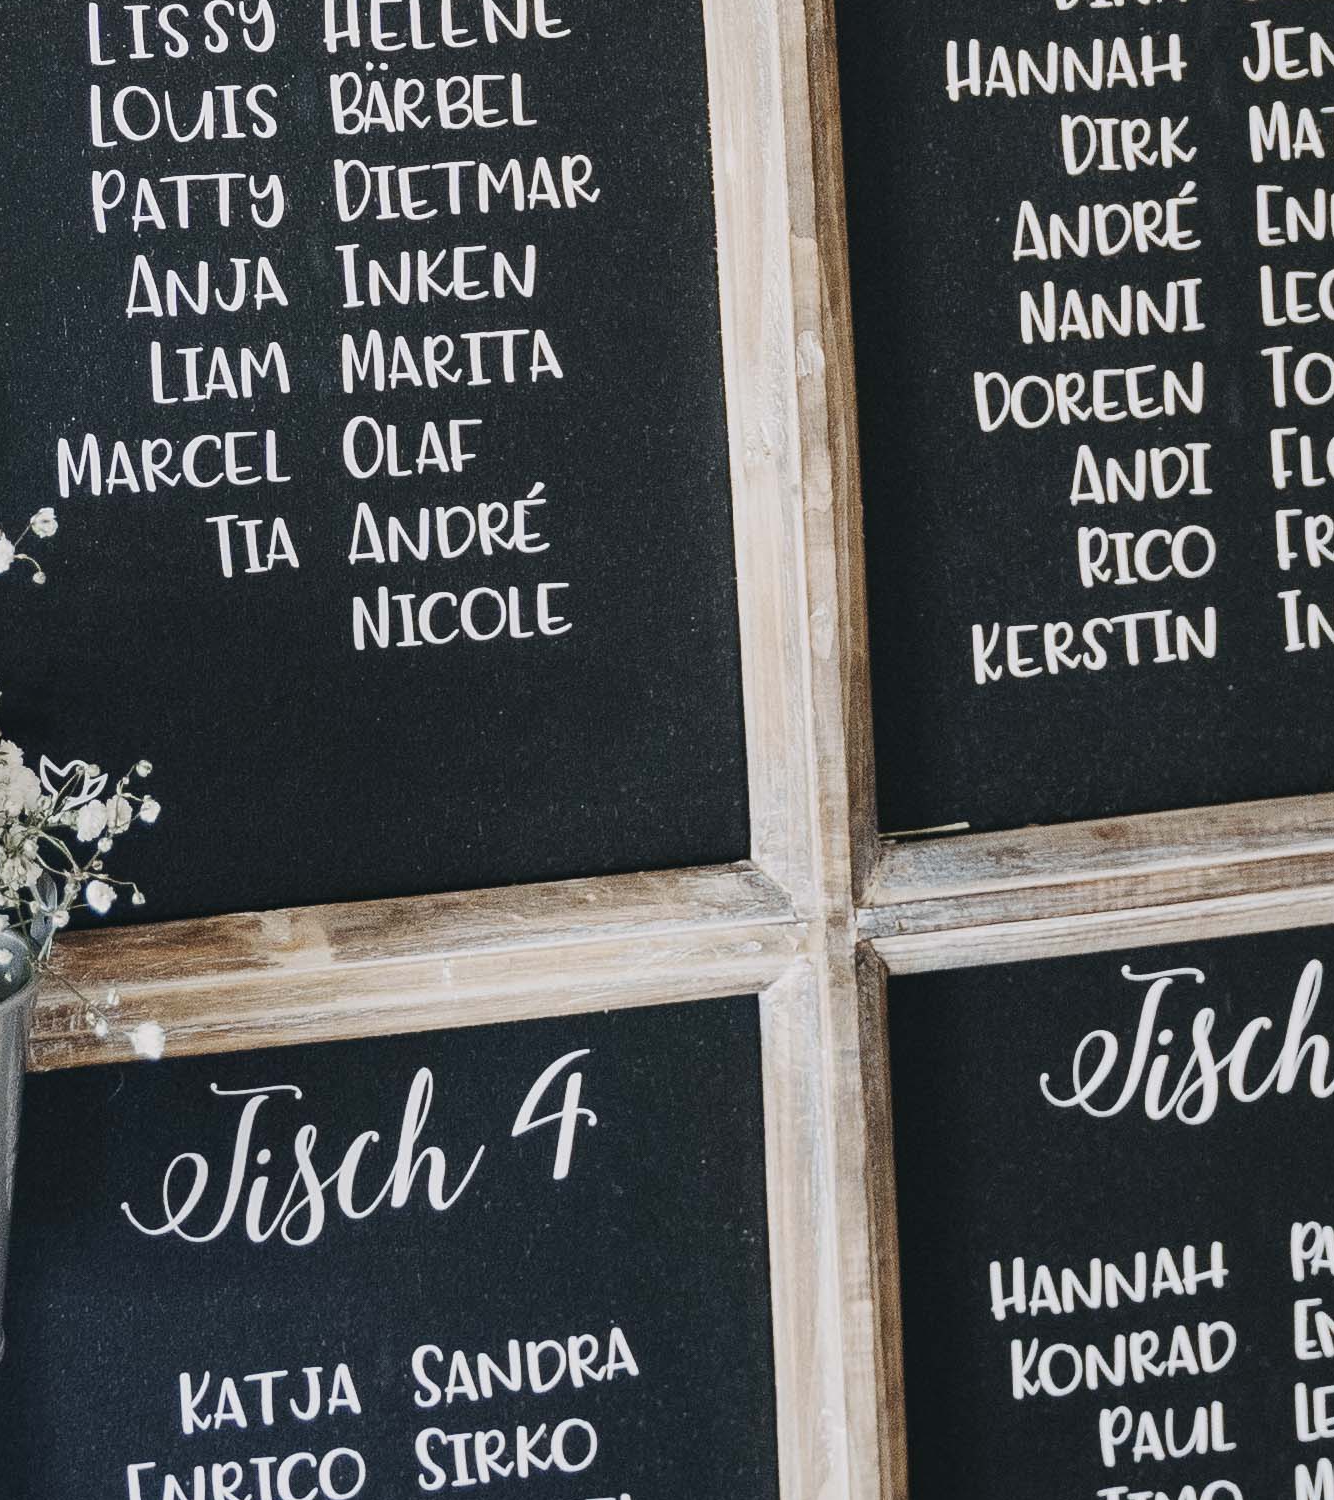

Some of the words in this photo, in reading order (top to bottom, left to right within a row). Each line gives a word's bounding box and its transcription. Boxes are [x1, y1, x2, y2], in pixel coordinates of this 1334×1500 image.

[89, 82, 279, 149] LOUIS
[328, 59, 539, 136] BÄRBEL
[944, 32, 1189, 103] HANNAH
[1059, 113, 1198, 177] DIRK
[90, 168, 286, 235] PATTY
[332, 153, 602, 224] DIETMAR
[1011, 179, 1203, 263] ANDRÉ
[124, 253, 290, 320] ANJA
[333, 242, 537, 310] INKEN
[1019, 276, 1207, 346] NANNI
[149, 339, 292, 405] LIAM
[340, 327, 565, 395] MARITA
[972, 360, 1205, 434] DOREEN
[56, 428, 293, 500] MARCEL
[341, 414, 484, 480] OLAF
[1068, 441, 1214, 507] ANDI
[204, 513, 301, 579] TIA
[346, 480, 552, 566] ANDRÉ
[1076, 523, 1218, 590] RICO
[351, 581, 574, 652] NICOLE
[970, 605, 1218, 686] KERSTIN
[119, 1065, 486, 1248] Tisch
[510, 1047, 599, 1181] 4
[988, 1239, 1230, 1322] HANNAH
[178, 1361, 363, 1436] KATJA
[410, 1325, 641, 1409] SANDRA
[1009, 1319, 1238, 1401] KONRAD
[413, 1416, 599, 1492] SIRKO
[1097, 1399, 1238, 1469] PAUL
